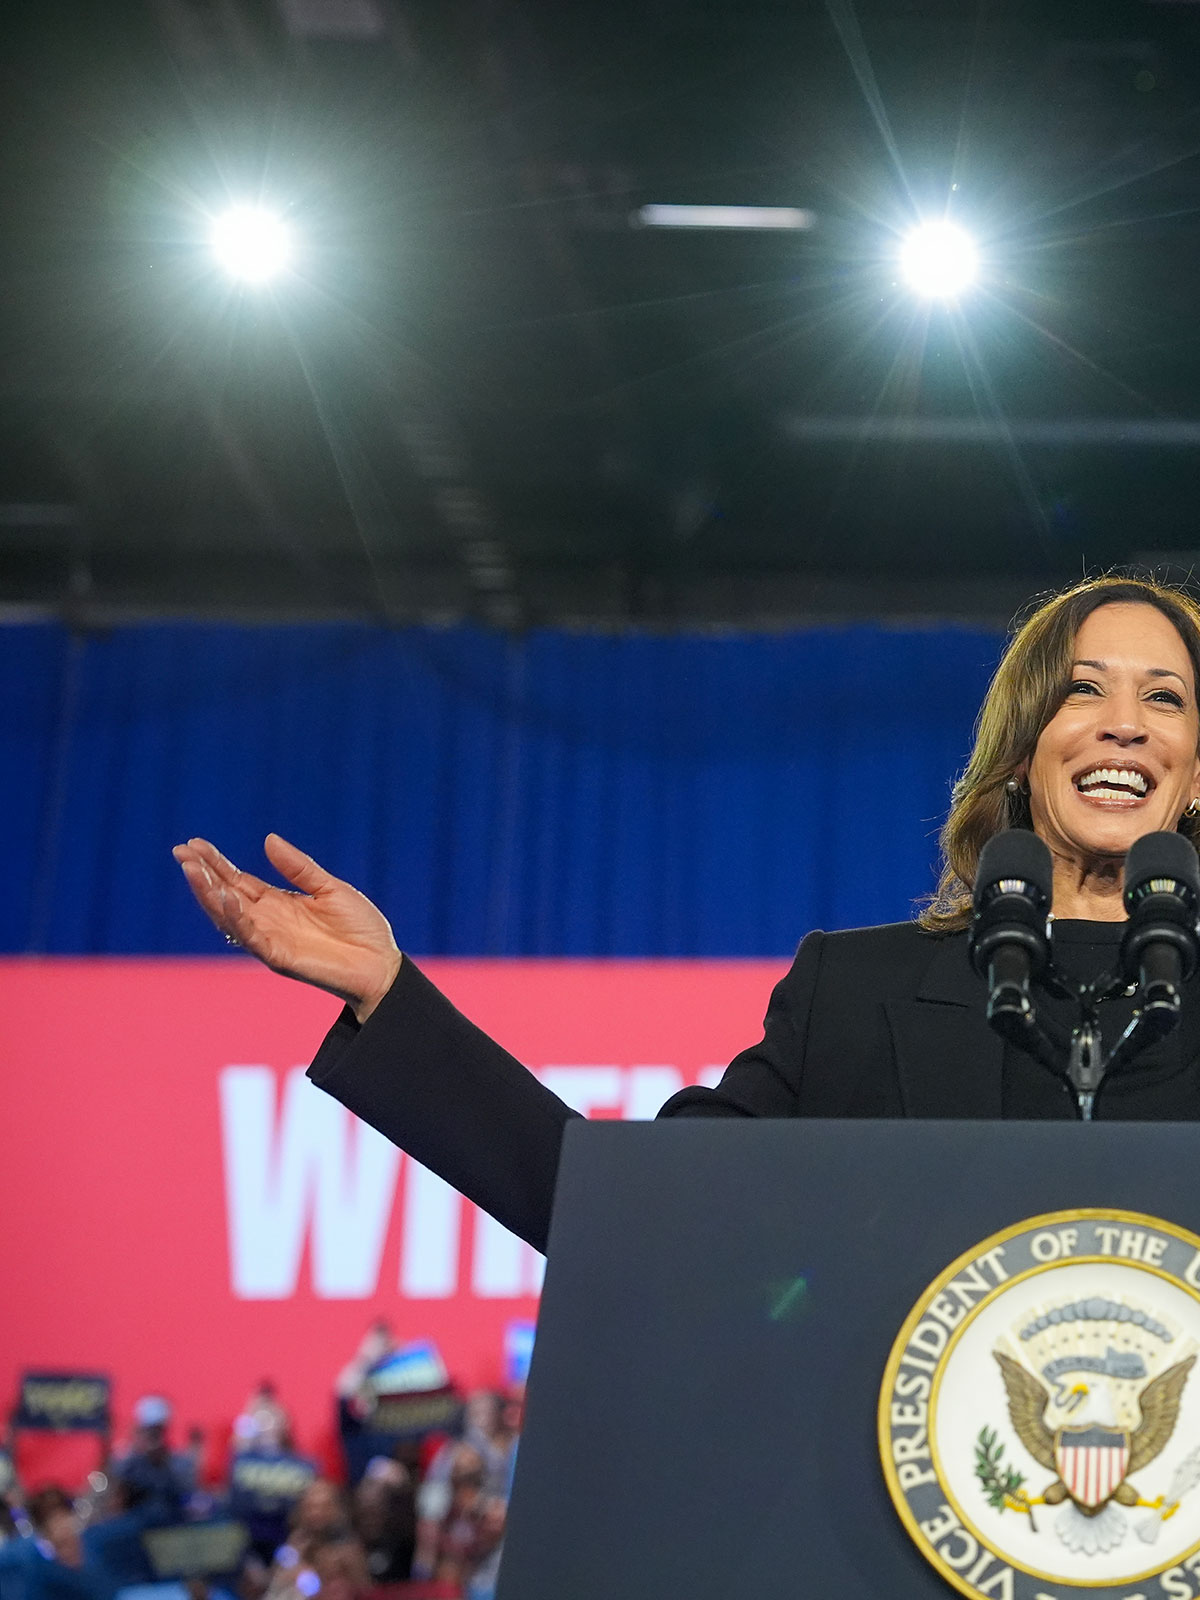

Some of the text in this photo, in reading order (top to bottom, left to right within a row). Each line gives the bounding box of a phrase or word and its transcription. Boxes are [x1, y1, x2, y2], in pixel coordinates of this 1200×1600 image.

[1031, 1229, 1079, 1263] OF
[1095, 1227, 1167, 1266] THE
[891, 1247, 1009, 1491] PRESIDENT
[920, 1505, 1016, 1600] VICE
